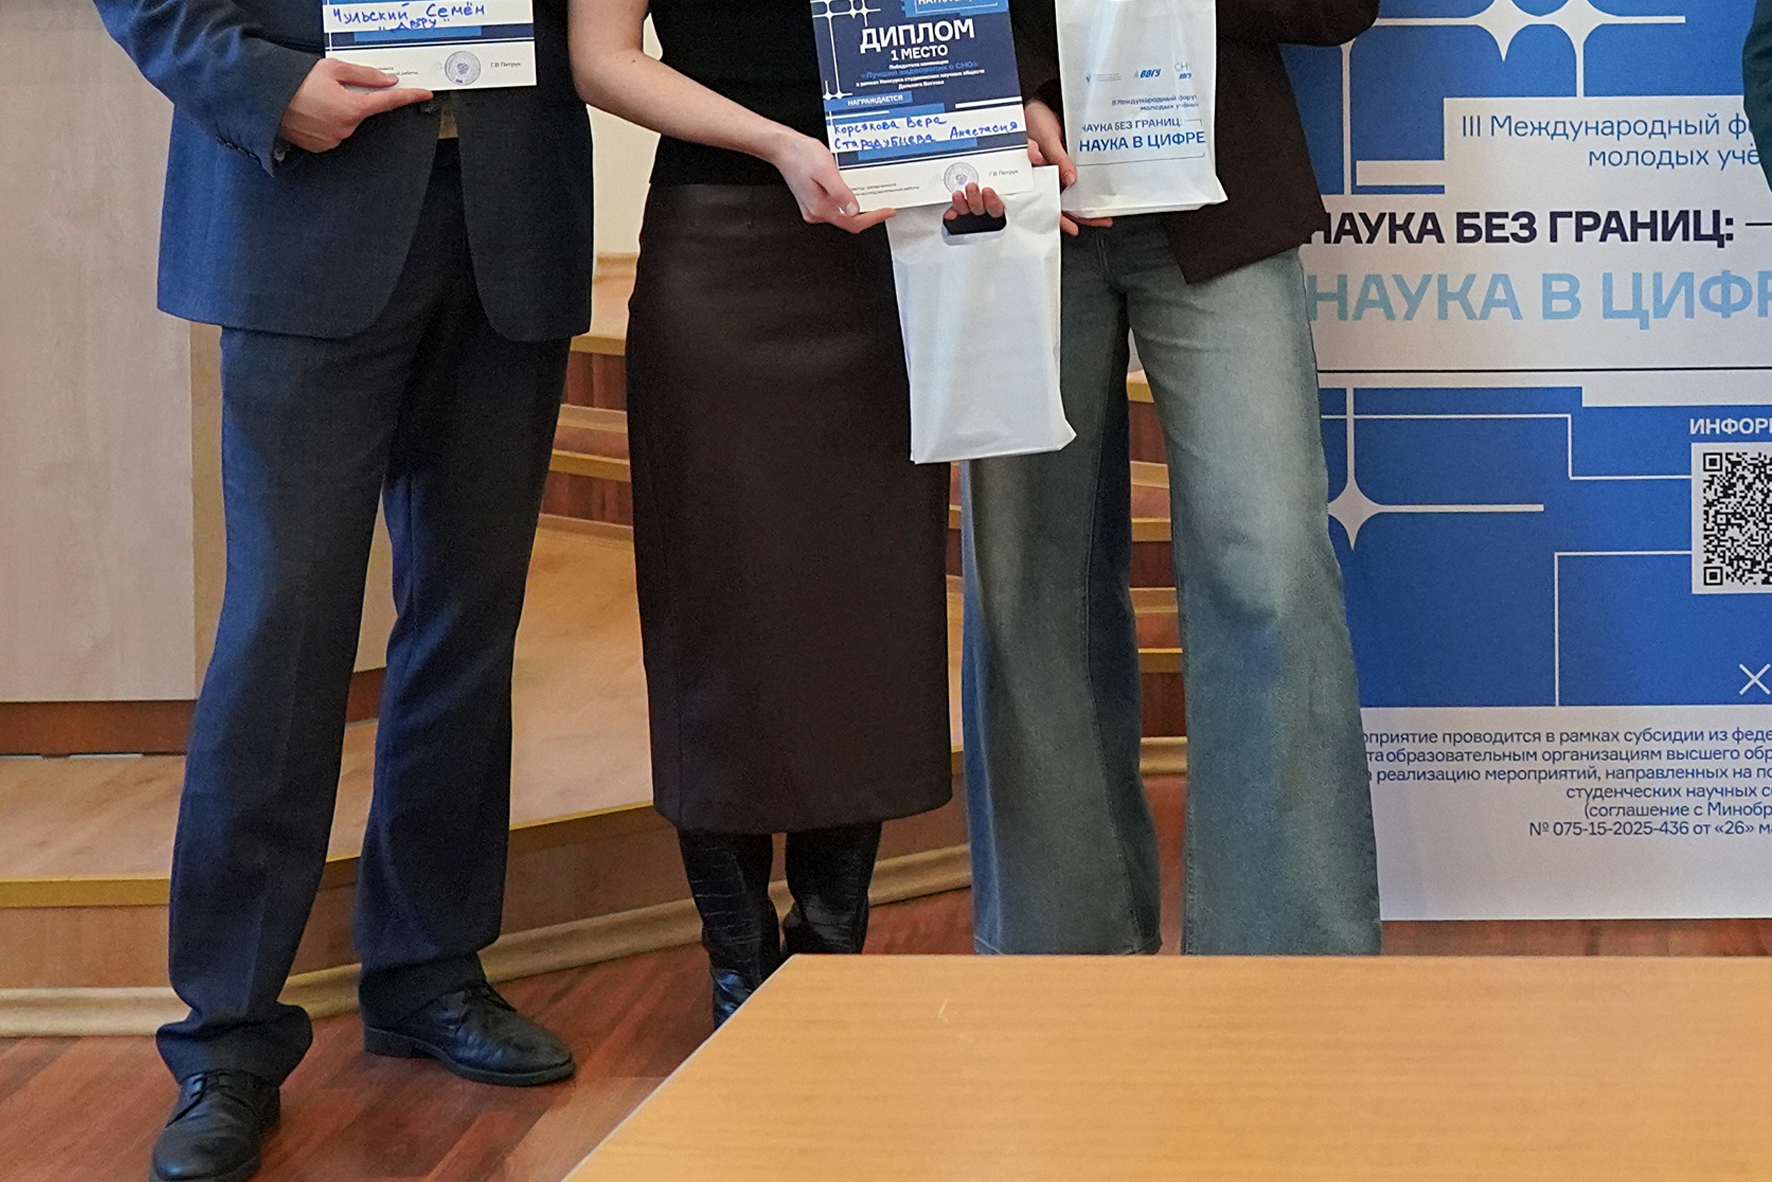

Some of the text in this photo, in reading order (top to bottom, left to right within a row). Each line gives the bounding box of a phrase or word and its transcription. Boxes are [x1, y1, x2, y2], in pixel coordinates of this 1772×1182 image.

[426, 0, 486, 18] Семён
[859, 18, 975, 54] ДИПЛОМ
[890, 44, 948, 61] 1 МЕСТО
[847, 94, 905, 106] НАГРАЖДАЕТСЯ
[906, 116, 948, 131] Вера
[949, 121, 1019, 139] Анастасия
[1114, 121, 1132, 131] БЕЗ
[1135, 118, 1182, 129] ГРАНИЦ:
[1461, 115, 1482, 137] III
[1490, 113, 1720, 141] Международный
[1079, 131, 1206, 152] НАУКА В ЦИФРЕ
[1589, 148, 1709, 169] молодых
[1456, 211, 1537, 244] БЕЗ
[1549, 210, 1735, 249] ГРАНИЦ:
[1307, 273, 1524, 321] НАУКА
[1542, 272, 1582, 320] В
[1442, 730, 1541, 746] проводится
[1546, 732, 1555, 743] в
[1559, 730, 1620, 746] рамках
[1623, 727, 1705, 745] субсидии
[1708, 729, 1728, 742] из
[1386, 748, 1538, 764] образовательным
[1541, 749, 1662, 764] организациям
[1666, 747, 1741, 761] высшего
[1377, 769, 1481, 784] реализацию
[1484, 765, 1601, 784] мероприятий,
[1605, 767, 1729, 782] направленных
[1733, 768, 1752, 780] на
[1566, 786, 1682, 801] студенческих
[1686, 786, 1757, 801] научных
[1584, 802, 1690, 820] (соглашение
[1693, 805, 1703, 816] с
[1529, 821, 1549, 837] №
[1552, 820, 1690, 837] 075-15-2025-436
[1692, 823, 1712, 835] от
[1714, 821, 1755, 835] «26»
